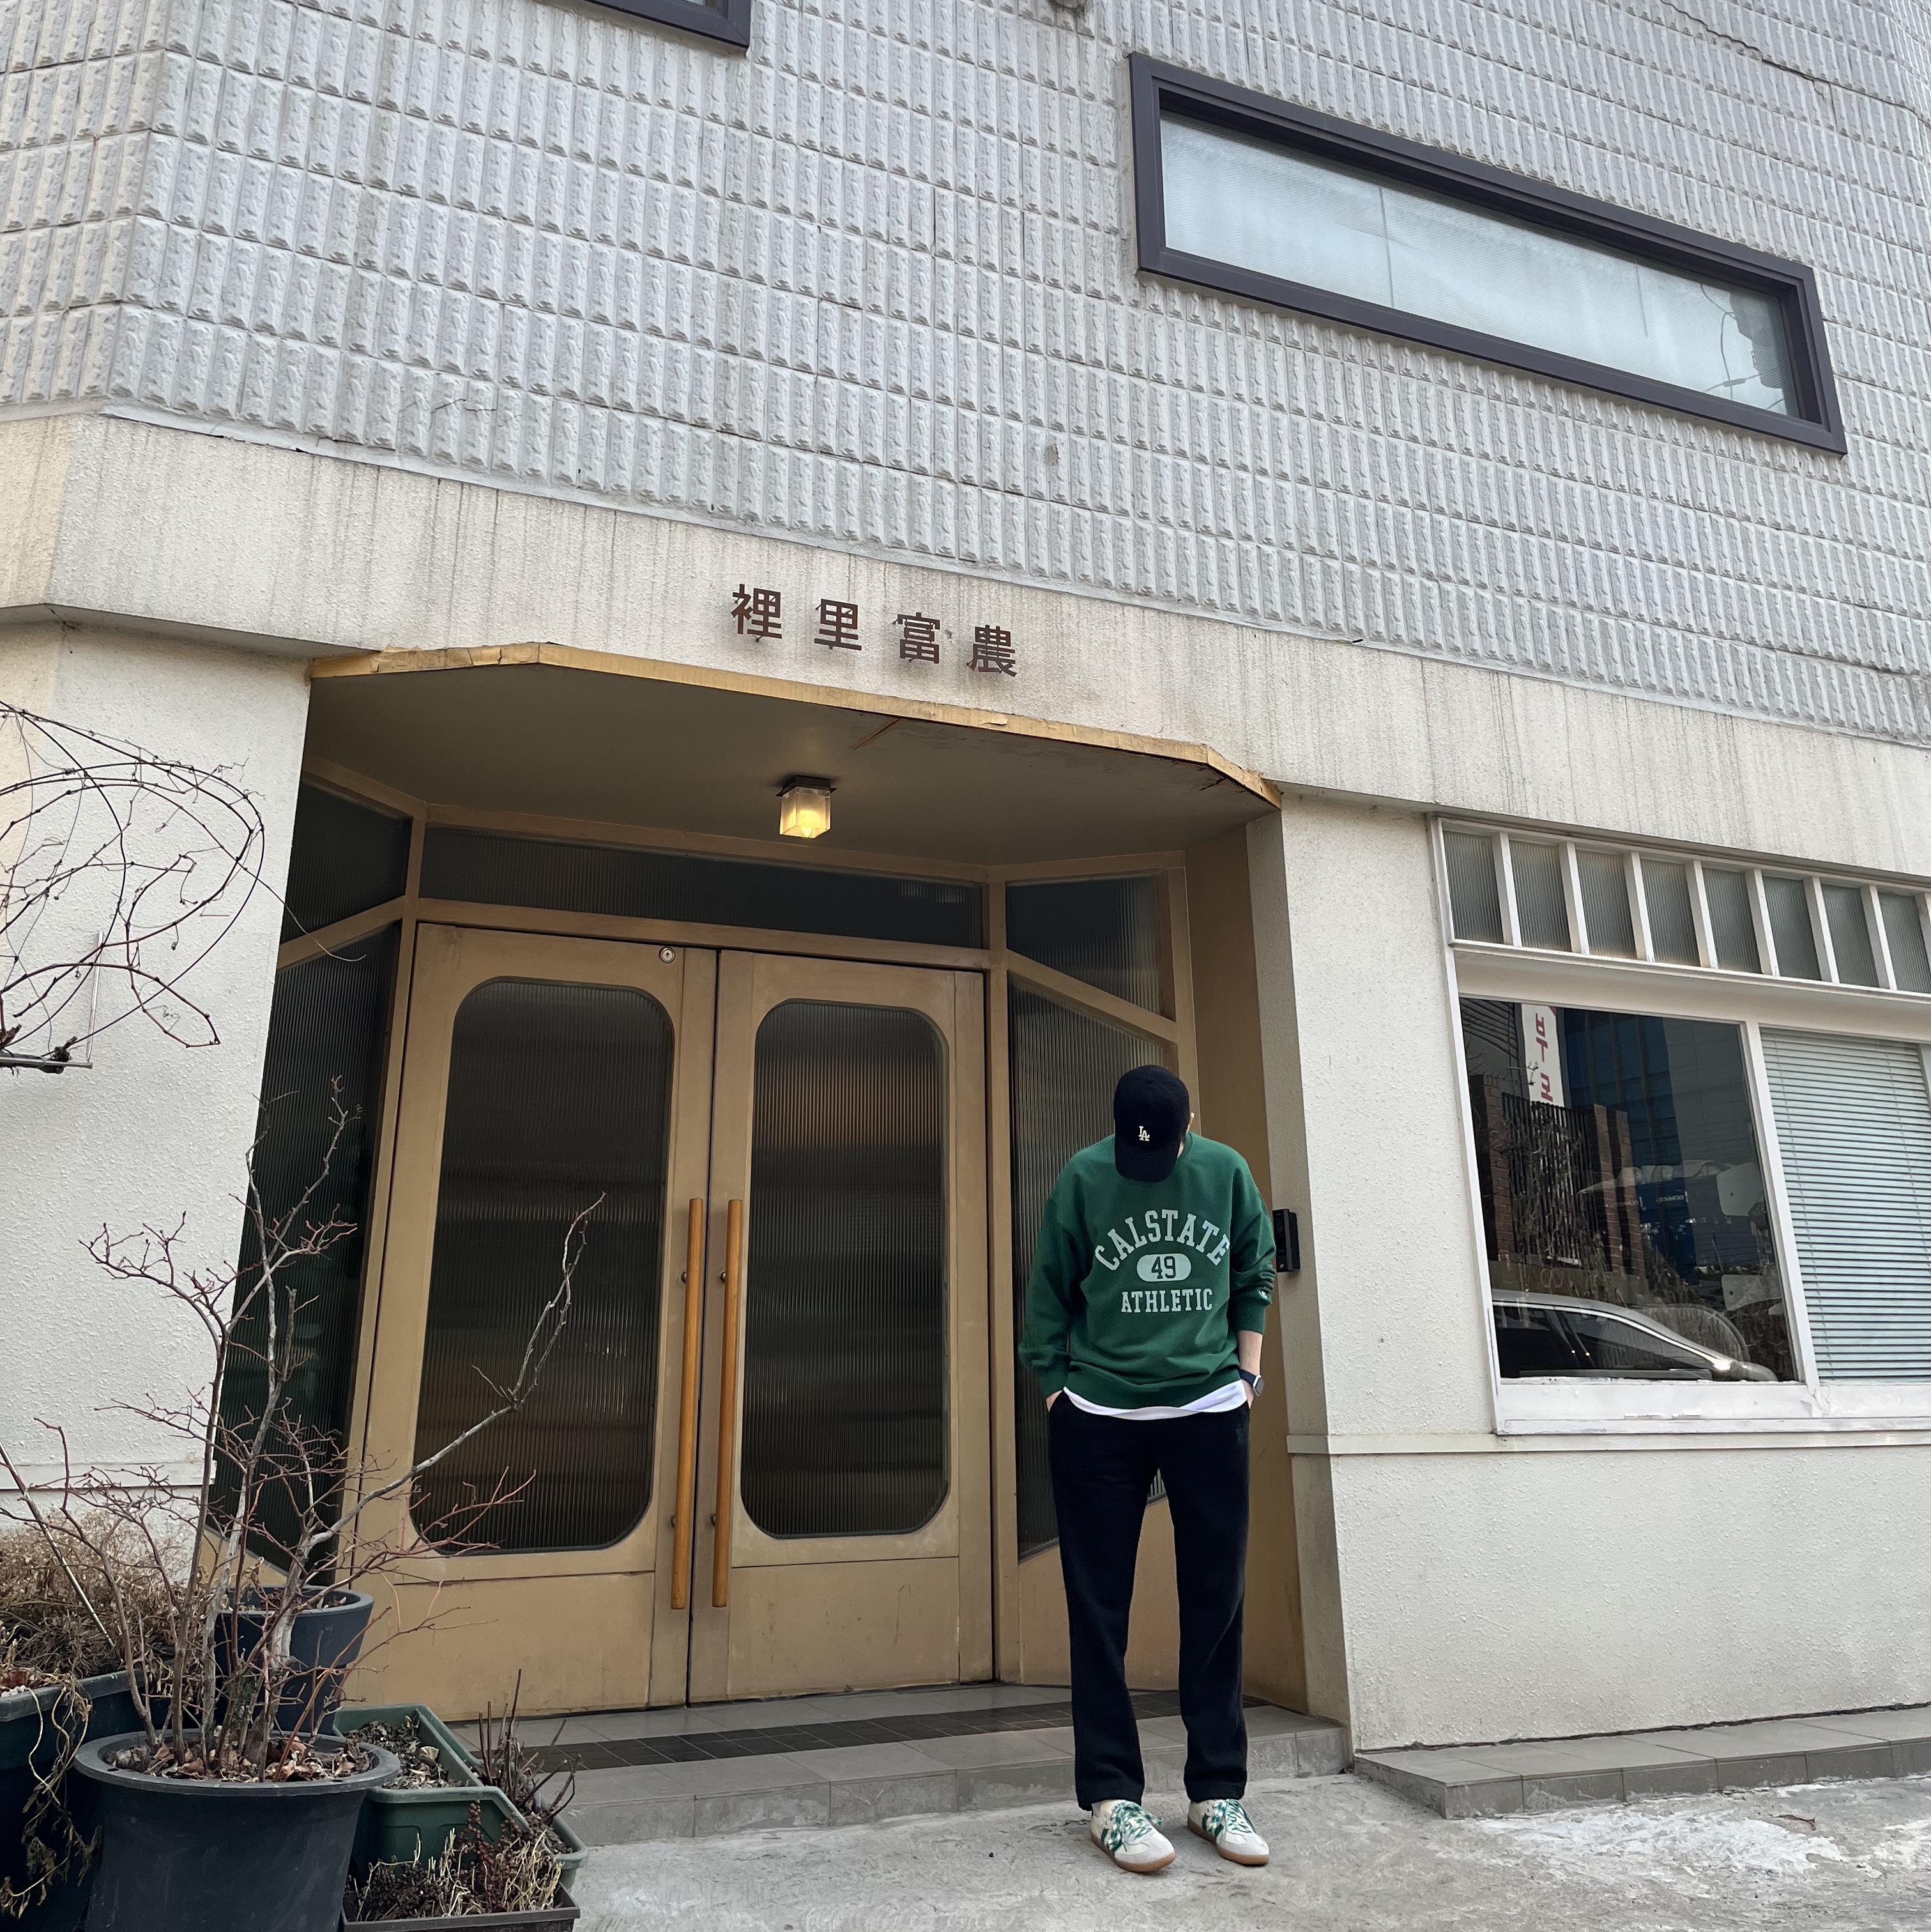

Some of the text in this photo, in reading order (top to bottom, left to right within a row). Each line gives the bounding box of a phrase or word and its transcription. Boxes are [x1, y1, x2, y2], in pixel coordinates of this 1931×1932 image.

[731, 583, 1018, 677] 裡里富農
[1138, 1125, 1150, 1142] LA
[1095, 1209, 1231, 1271] CALSTATE
[1150, 1255, 1177, 1280] 49
[1121, 1288, 1213, 1314] ATHLETIC
